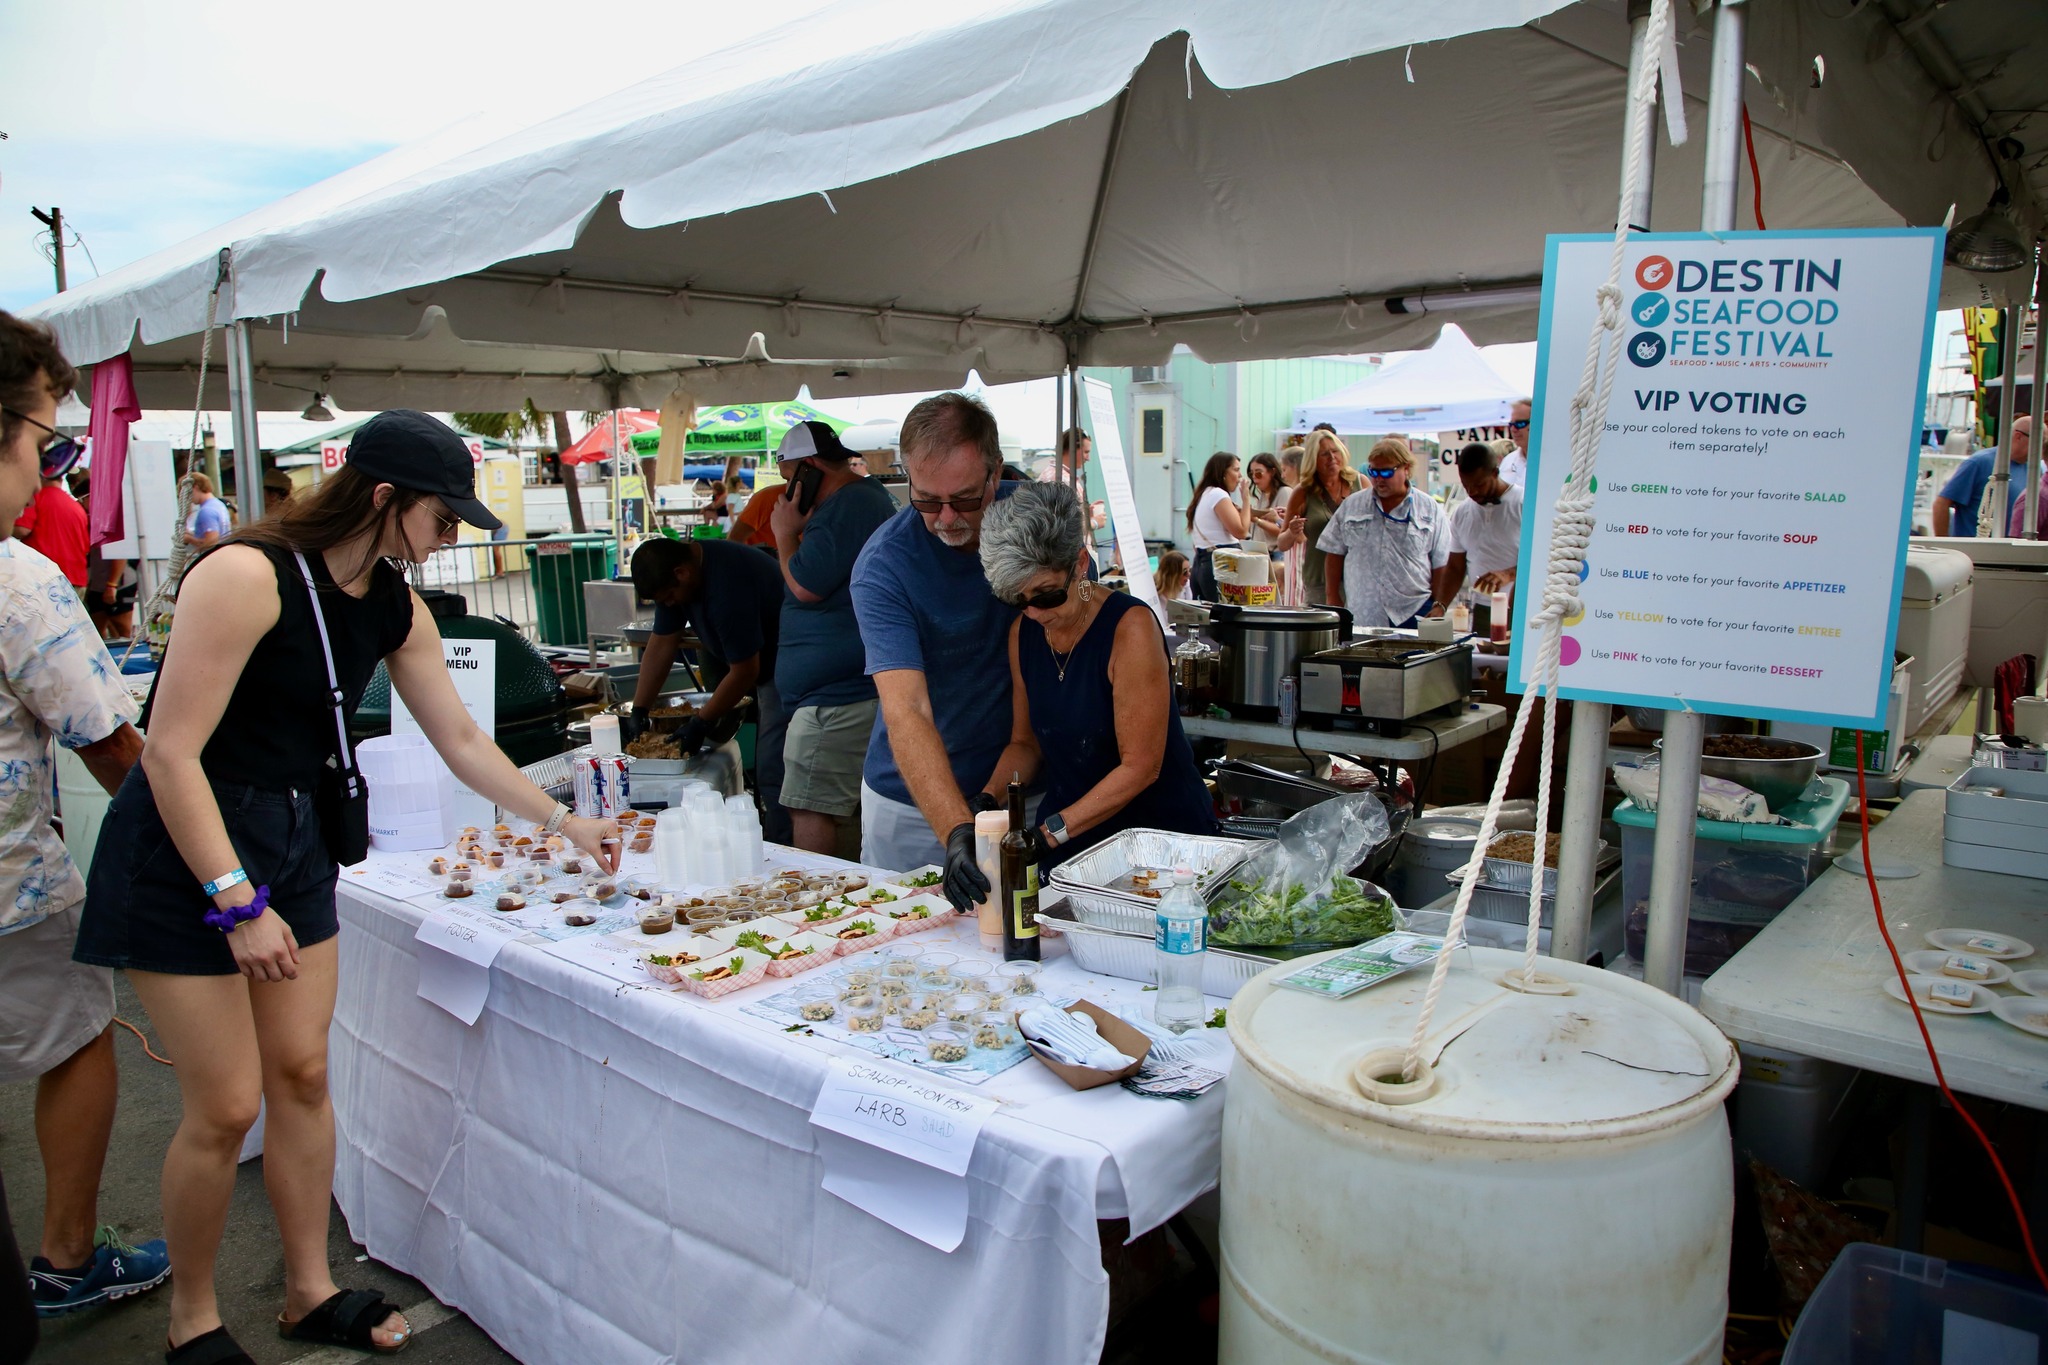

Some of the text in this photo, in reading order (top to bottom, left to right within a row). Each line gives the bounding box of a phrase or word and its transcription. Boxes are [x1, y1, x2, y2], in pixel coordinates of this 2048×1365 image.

[1675, 259, 1841, 293] DESTIN
[1674, 299, 1838, 325] SEAFOOD
[1671, 331, 1832, 358] FESTIVAL
[1634, 390, 1806, 415] VIP VOTING
[1457, 426, 1514, 442] PAYN
[1623, 425, 1648, 434] your
[1652, 422, 1697, 434] colored
[1702, 424, 1740, 435] tokens
[1745, 427, 1757, 436] to
[1762, 428, 1788, 437] vote
[1813, 428, 1844, 438] each
[1670, 441, 1768, 456] item separately!
[1609, 483, 1846, 502] Use GREEN to vote for your favorite SALAD
[1606, 524, 1624, 533] Use
[1628, 525, 1648, 534] RED
[1652, 527, 1662, 535] to
[1693, 528, 1708, 537] for
[1711, 533, 1734, 542] your
[1738, 530, 1779, 542] favorite
[1784, 534, 1817, 544] SOUP
[1223, 583, 1246, 595] HUSKY
[1251, 585, 1274, 593] HUSKY
[1600, 568, 1619, 577] Use
[1623, 570, 1649, 579] BLUE
[1667, 574, 1689, 582] vote
[1693, 574, 1708, 583] for
[1711, 579, 1734, 588] your
[1738, 577, 1779, 589] favorite
[1783, 581, 1845, 593] APPETIZER
[1595, 609, 1841, 637] Use YELLOW to vote for your favorite ENTREE
[453, 647, 472, 656] VIP
[446, 659, 478, 669] MENU
[1592, 649, 1610, 659] Use
[1613, 651, 1638, 661] PINK
[1655, 657, 1677, 665] vote
[1681, 657, 1696, 666] for
[1699, 662, 1722, 671] your
[1726, 661, 1767, 673] favorite
[1771, 666, 1823, 678] DESSERT
[375, 828, 399, 836] MARKET
[445, 922, 478, 943] FOSTER
[848, 1065, 907, 1088] SCALLOP
[945, 1098, 974, 1113] FISH
[855, 1096, 907, 1127] LARB
[922, 1116, 955, 1138] SALAD
